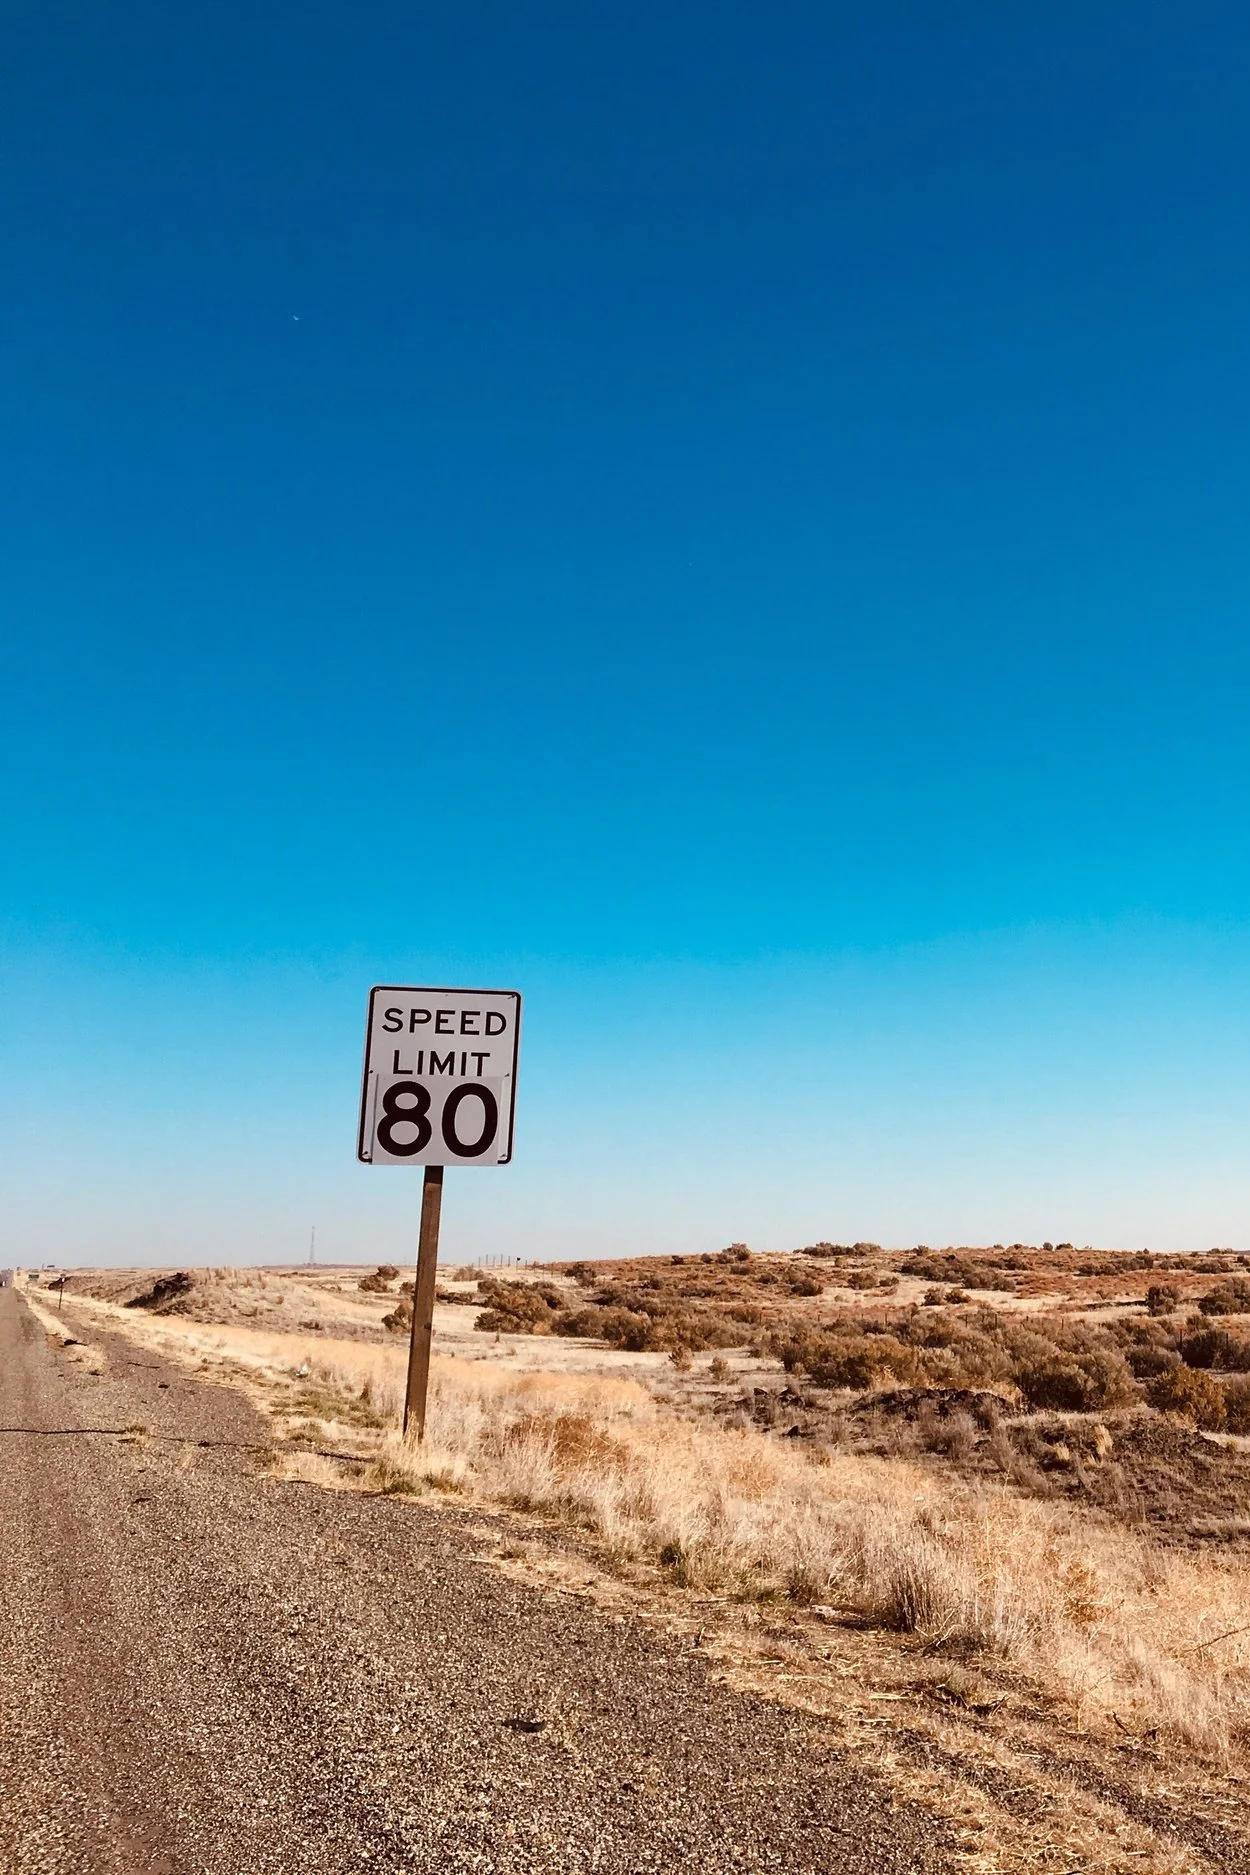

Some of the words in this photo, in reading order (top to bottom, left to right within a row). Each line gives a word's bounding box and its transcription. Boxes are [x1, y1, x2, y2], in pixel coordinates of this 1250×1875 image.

[381, 1008, 506, 1036] SPEED
[392, 1049, 491, 1077] LIMIT
[376, 1080, 499, 1158] 80
